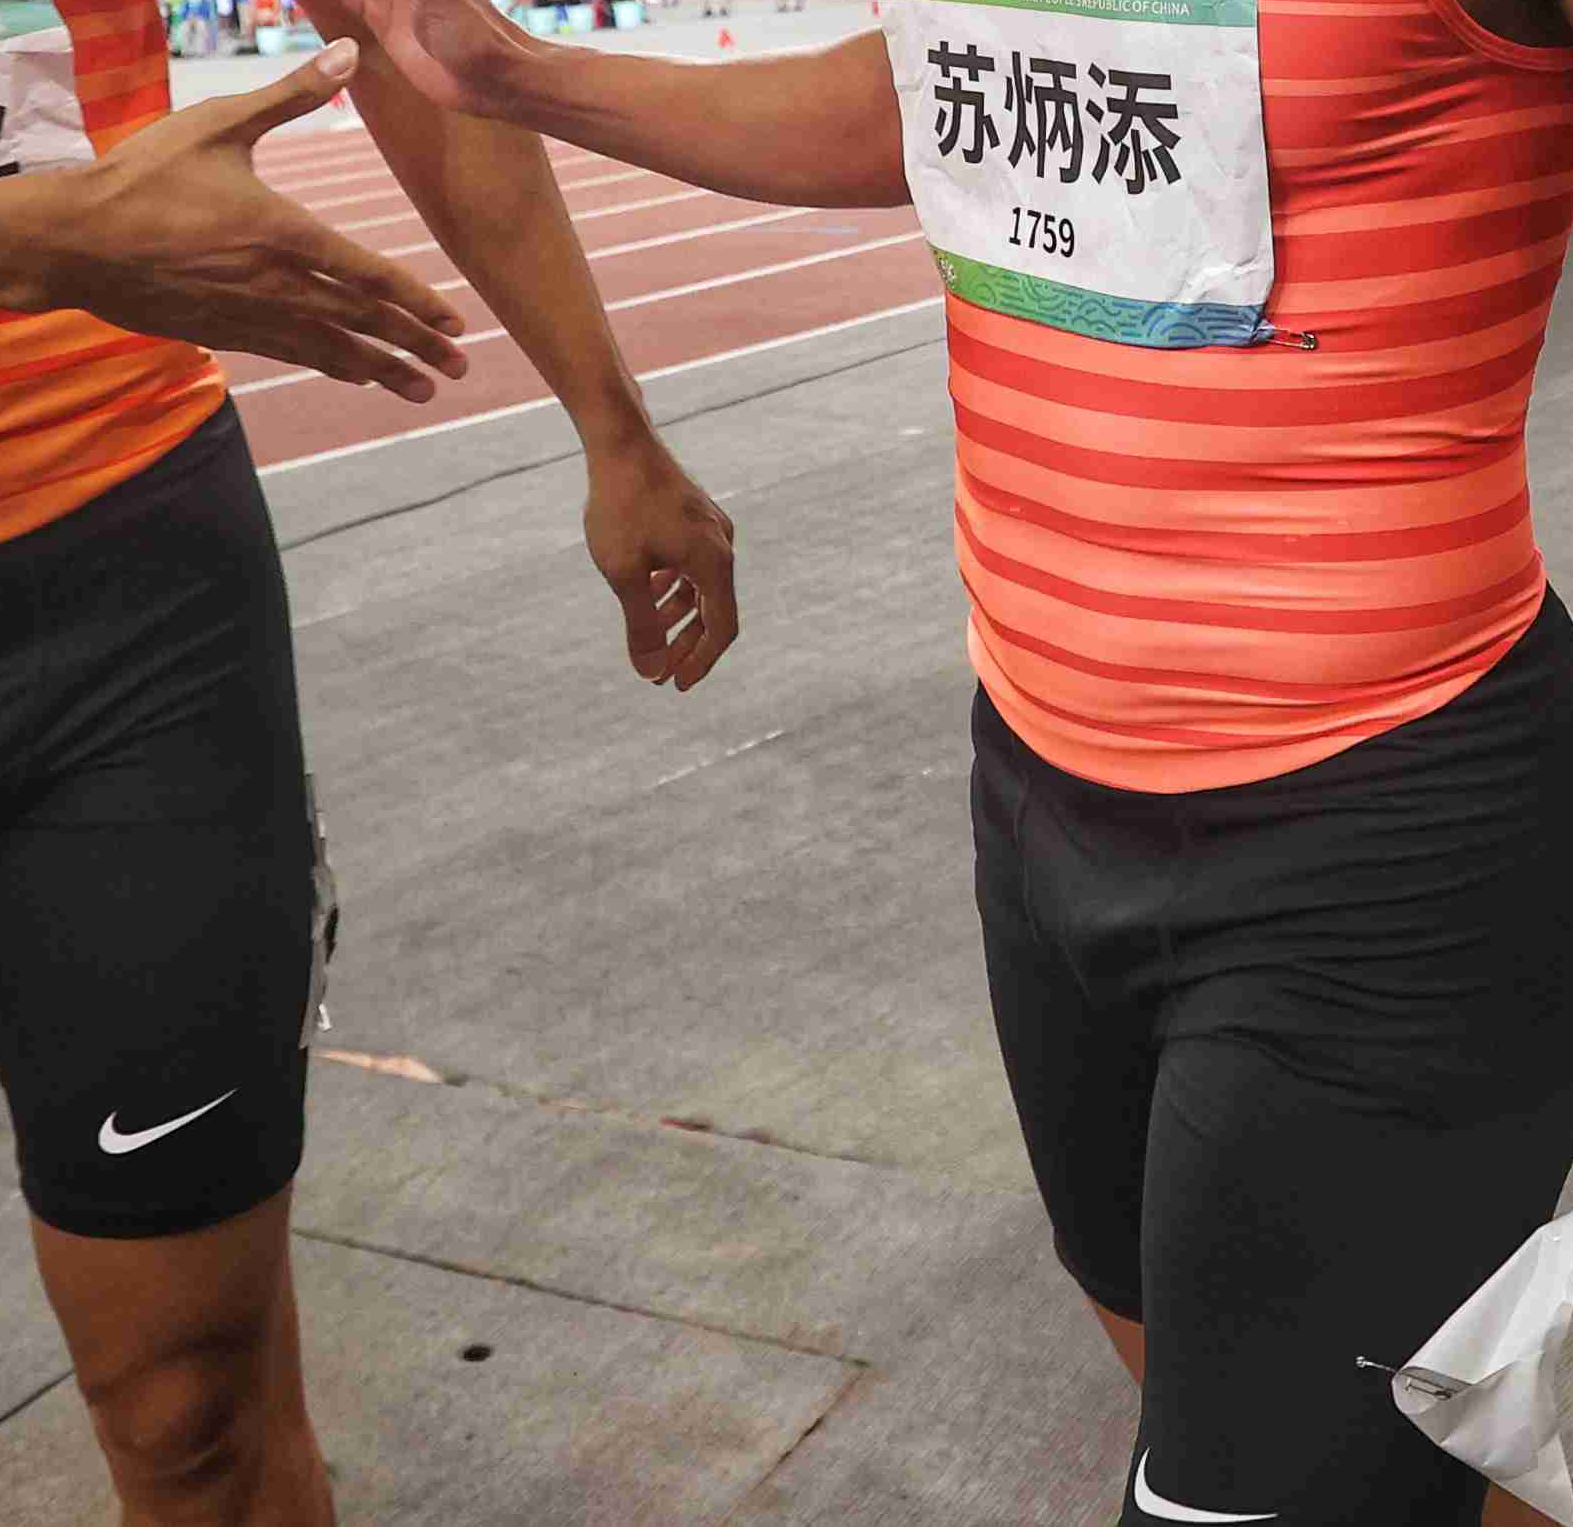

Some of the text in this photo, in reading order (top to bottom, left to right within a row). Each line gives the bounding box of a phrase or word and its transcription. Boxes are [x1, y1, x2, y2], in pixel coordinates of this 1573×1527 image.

[1132, 0, 1151, 13] OF
[1151, 1, 1190, 15] CHINA
[927, 41, 1183, 195] 苏炳添
[1008, 207, 1075, 258] 1759
